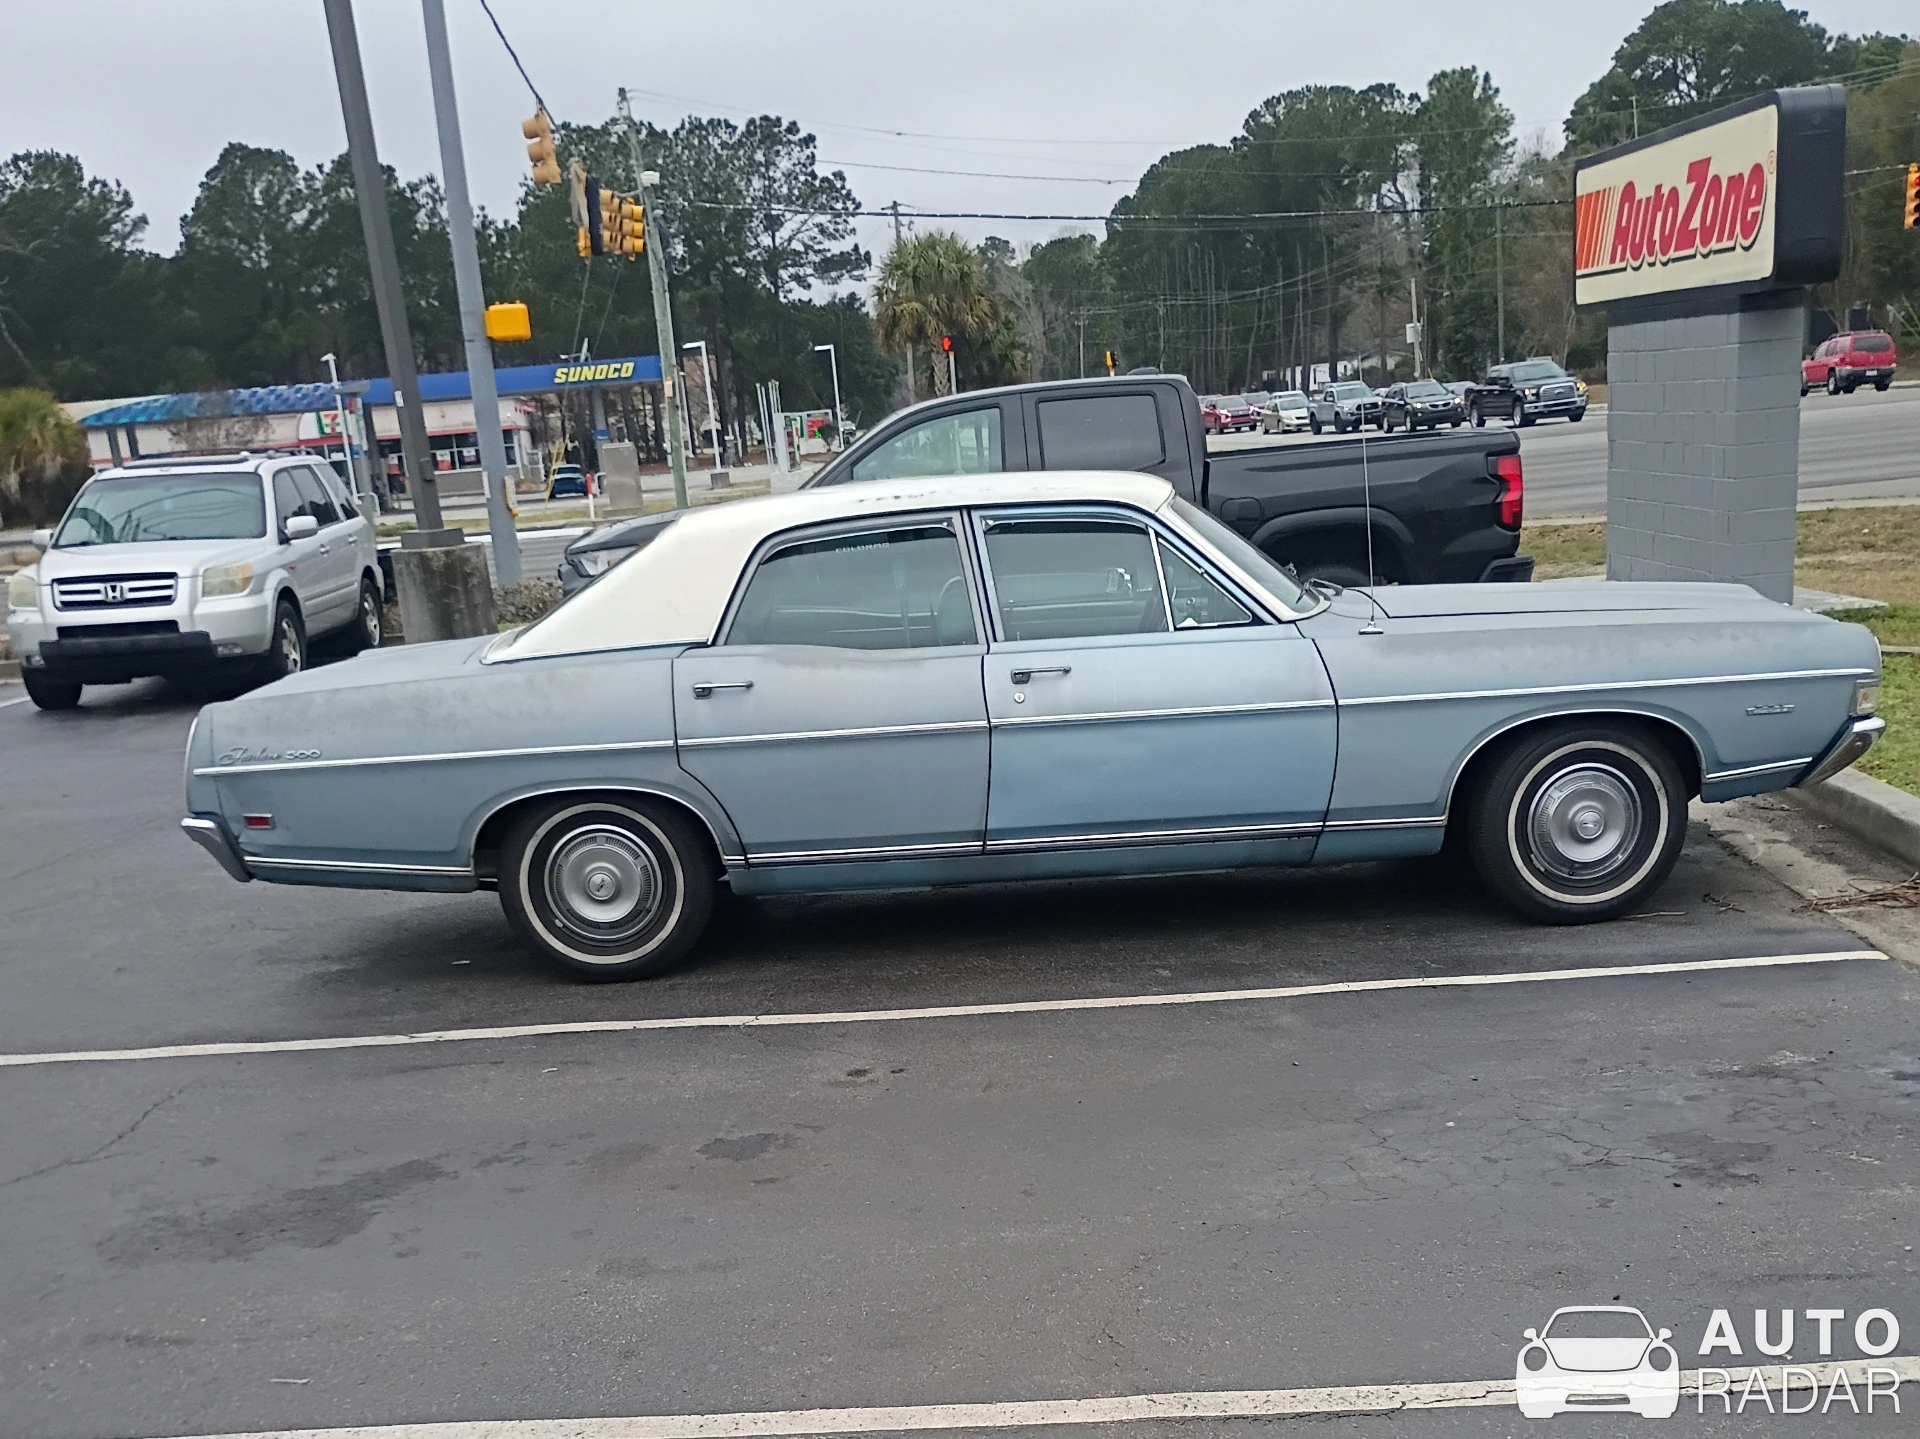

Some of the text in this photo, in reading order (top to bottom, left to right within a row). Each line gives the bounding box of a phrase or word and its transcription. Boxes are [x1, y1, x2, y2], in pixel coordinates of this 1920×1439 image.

[1609, 156, 1766, 264] AutoZone
[554, 362, 634, 384] SUNOCO
[285, 748, 322, 760] 500
